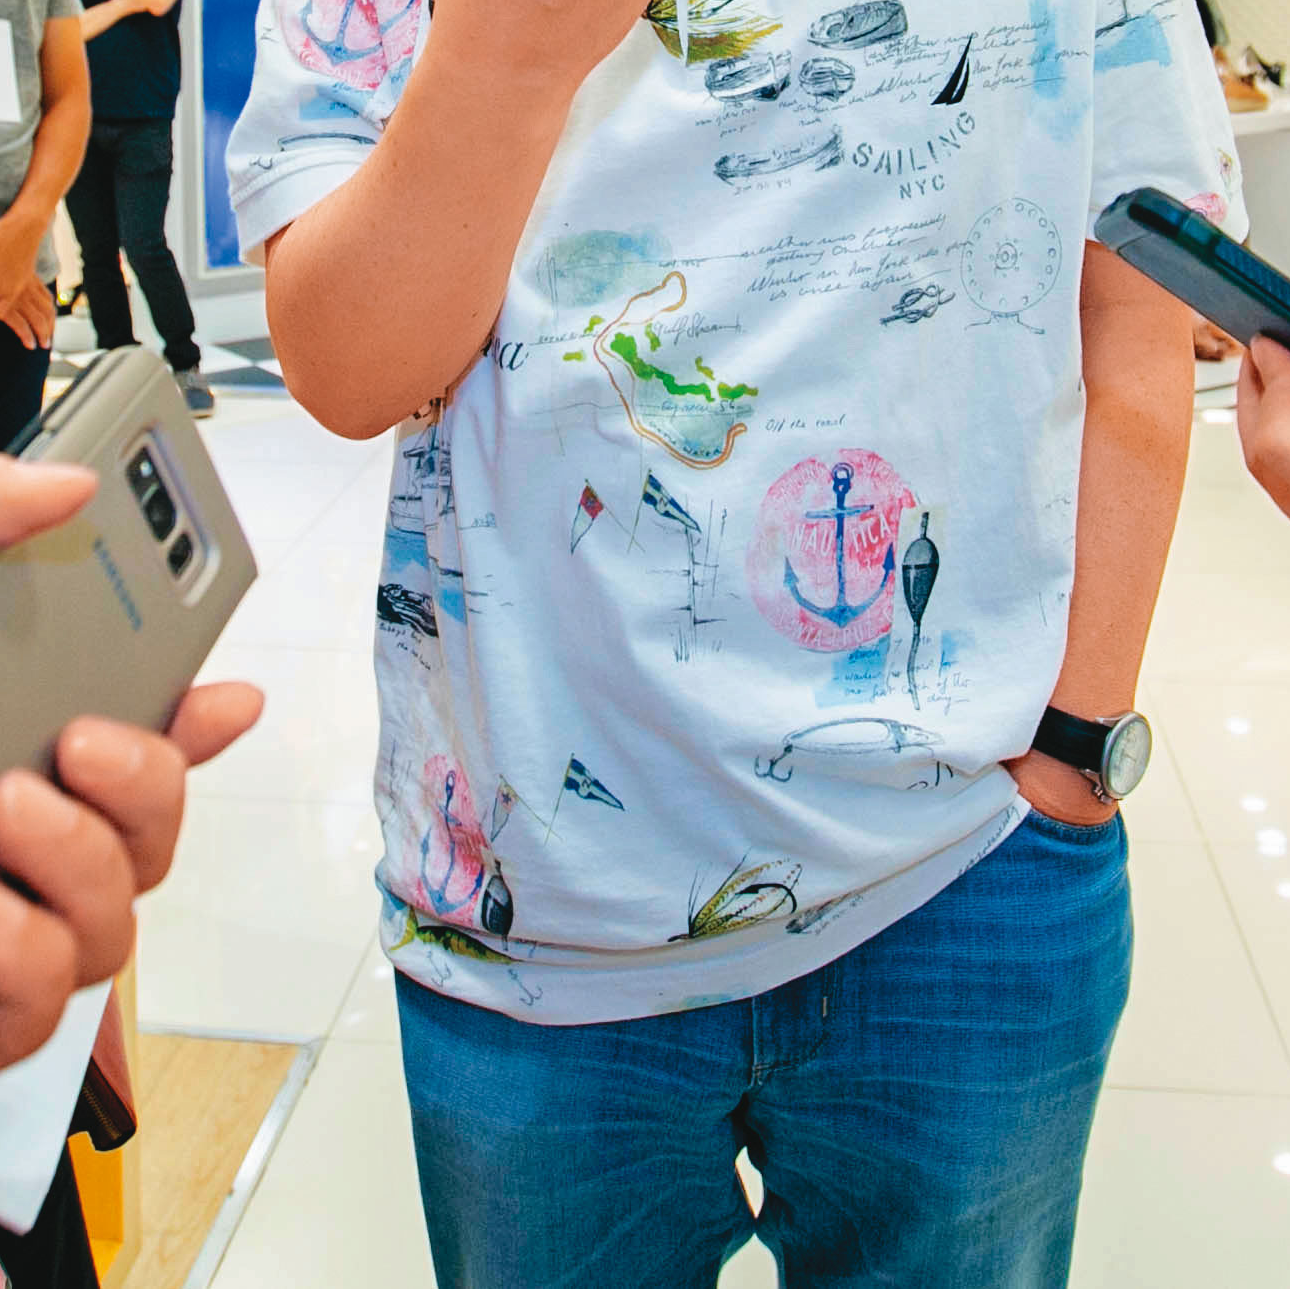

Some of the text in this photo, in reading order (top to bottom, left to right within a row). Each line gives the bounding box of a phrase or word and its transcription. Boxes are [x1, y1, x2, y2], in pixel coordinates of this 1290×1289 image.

[852, 111, 976, 176] SAILING
[899, 174, 946, 200] NYC
[790, 509, 893, 558] NAUTICA
